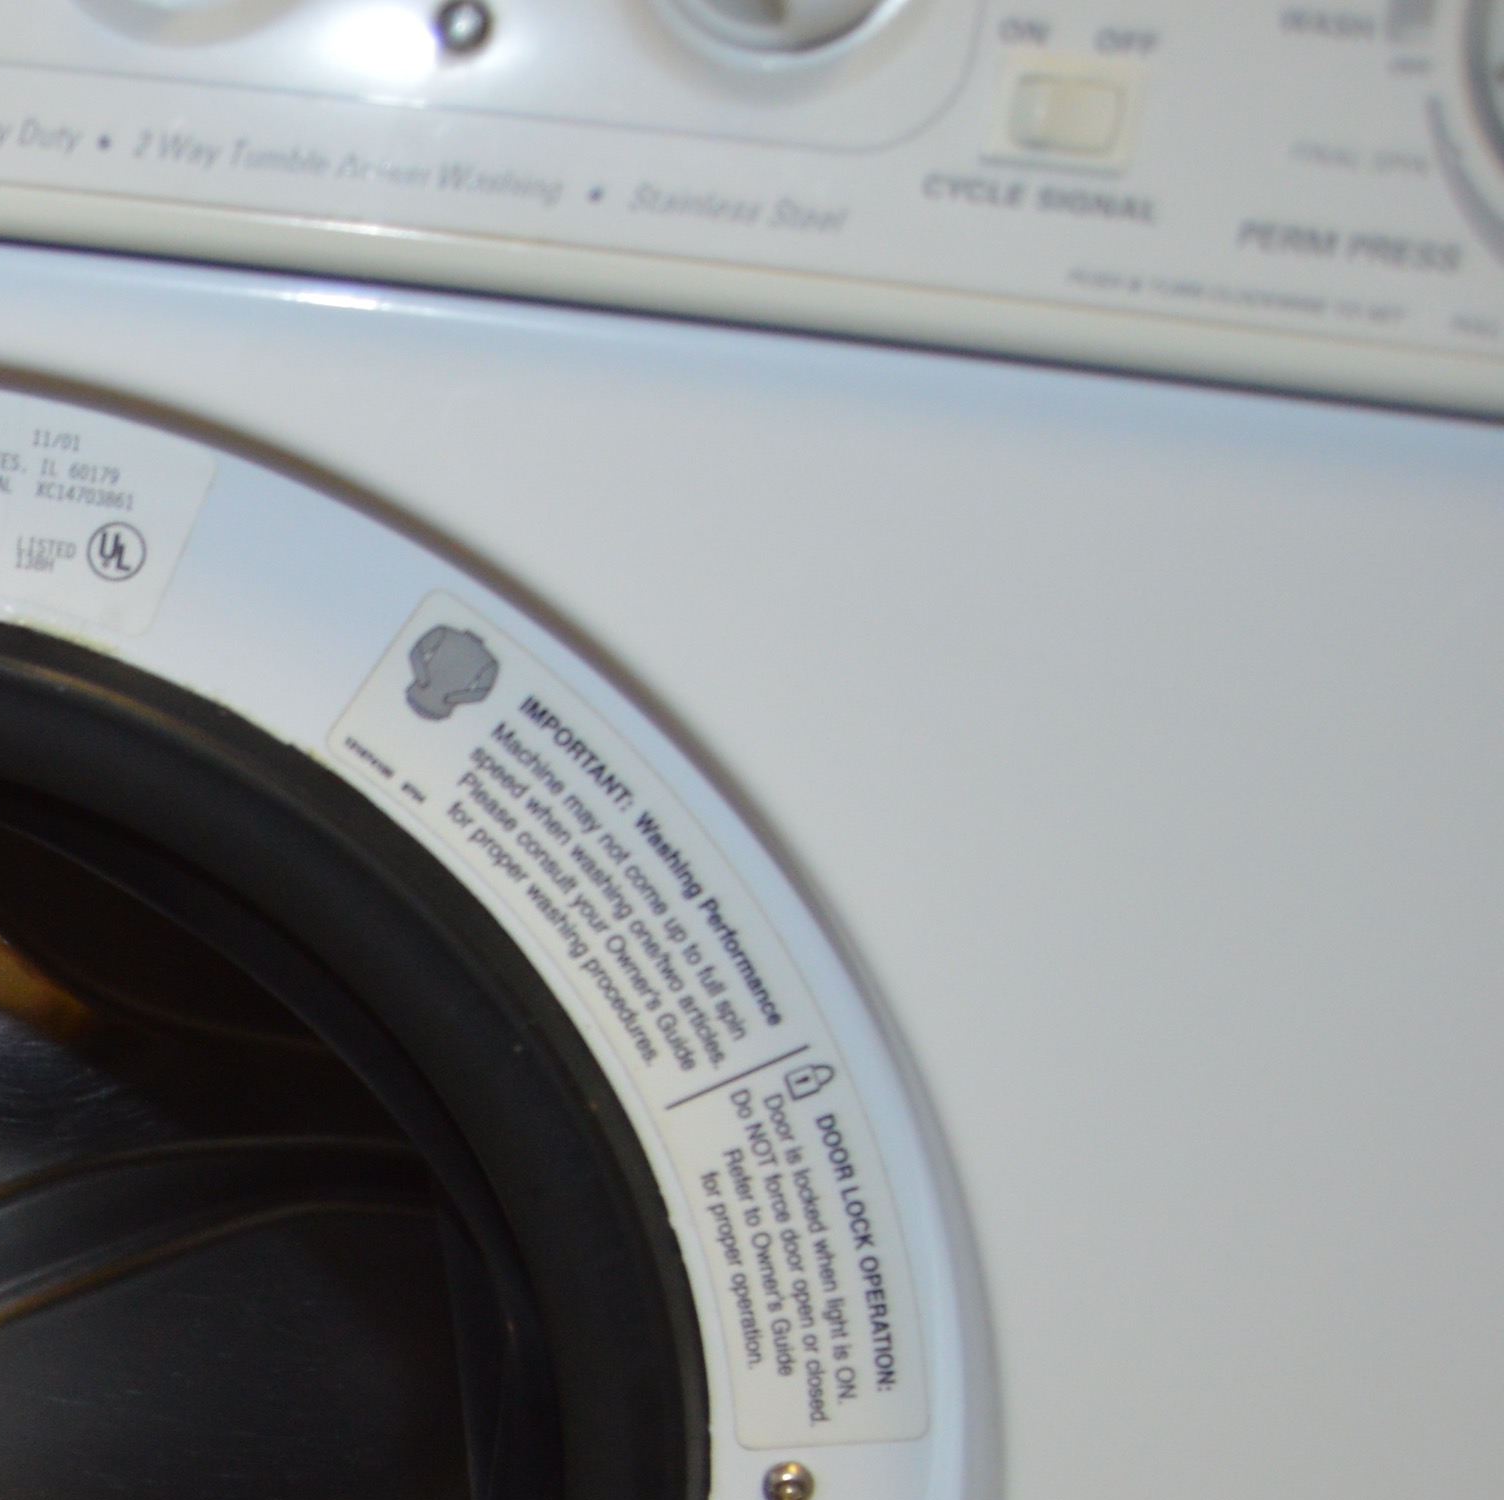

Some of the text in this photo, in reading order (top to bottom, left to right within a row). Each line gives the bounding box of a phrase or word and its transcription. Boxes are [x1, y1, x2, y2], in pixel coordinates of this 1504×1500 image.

[998, 16, 1161, 57] ON OFF
[17, 115, 81, 155] Duty
[134, 129, 152, 158] 2
[158, 133, 221, 169] Way
[231, 137, 330, 174] Tumble
[438, 163, 563, 206] Washing
[628, 181, 848, 234] Stainless Steel
[922, 172, 1157, 225] CYCLE SIGNAL
[1236, 218, 1463, 277] PERM PRESS
[33, 429, 80, 452] 11/01
[40, 458, 58, 478] IL
[68, 462, 120, 486] 60179
[16, 535, 77, 560] LISTED
[491, 722, 748, 1042] Machine may not come up to full spin
[519, 696, 783, 1027] IMPORTANT: Washing Performance
[447, 800, 659, 1068] for proper washing procedures.
[456, 770, 697, 1072] Please consult your Owner's Guide
[469, 746, 726, 1070] speed when washing one/two articles.
[729, 1088, 753, 1120] Do
[744, 1120, 778, 1167] NOT
[763, 1172, 791, 1224] force
[700, 1170, 764, 1371] for proper operation.
[723, 1147, 797, 1378] Refer to Owner's Guide
[762, 1092, 859, 1406] Door is locked when light is ON.
[779, 1228, 805, 1273] door
[815, 1112, 897, 1393] DOOR LOCK OPERATION:
[790, 1278, 816, 1329] open
[801, 1333, 819, 1354] or
